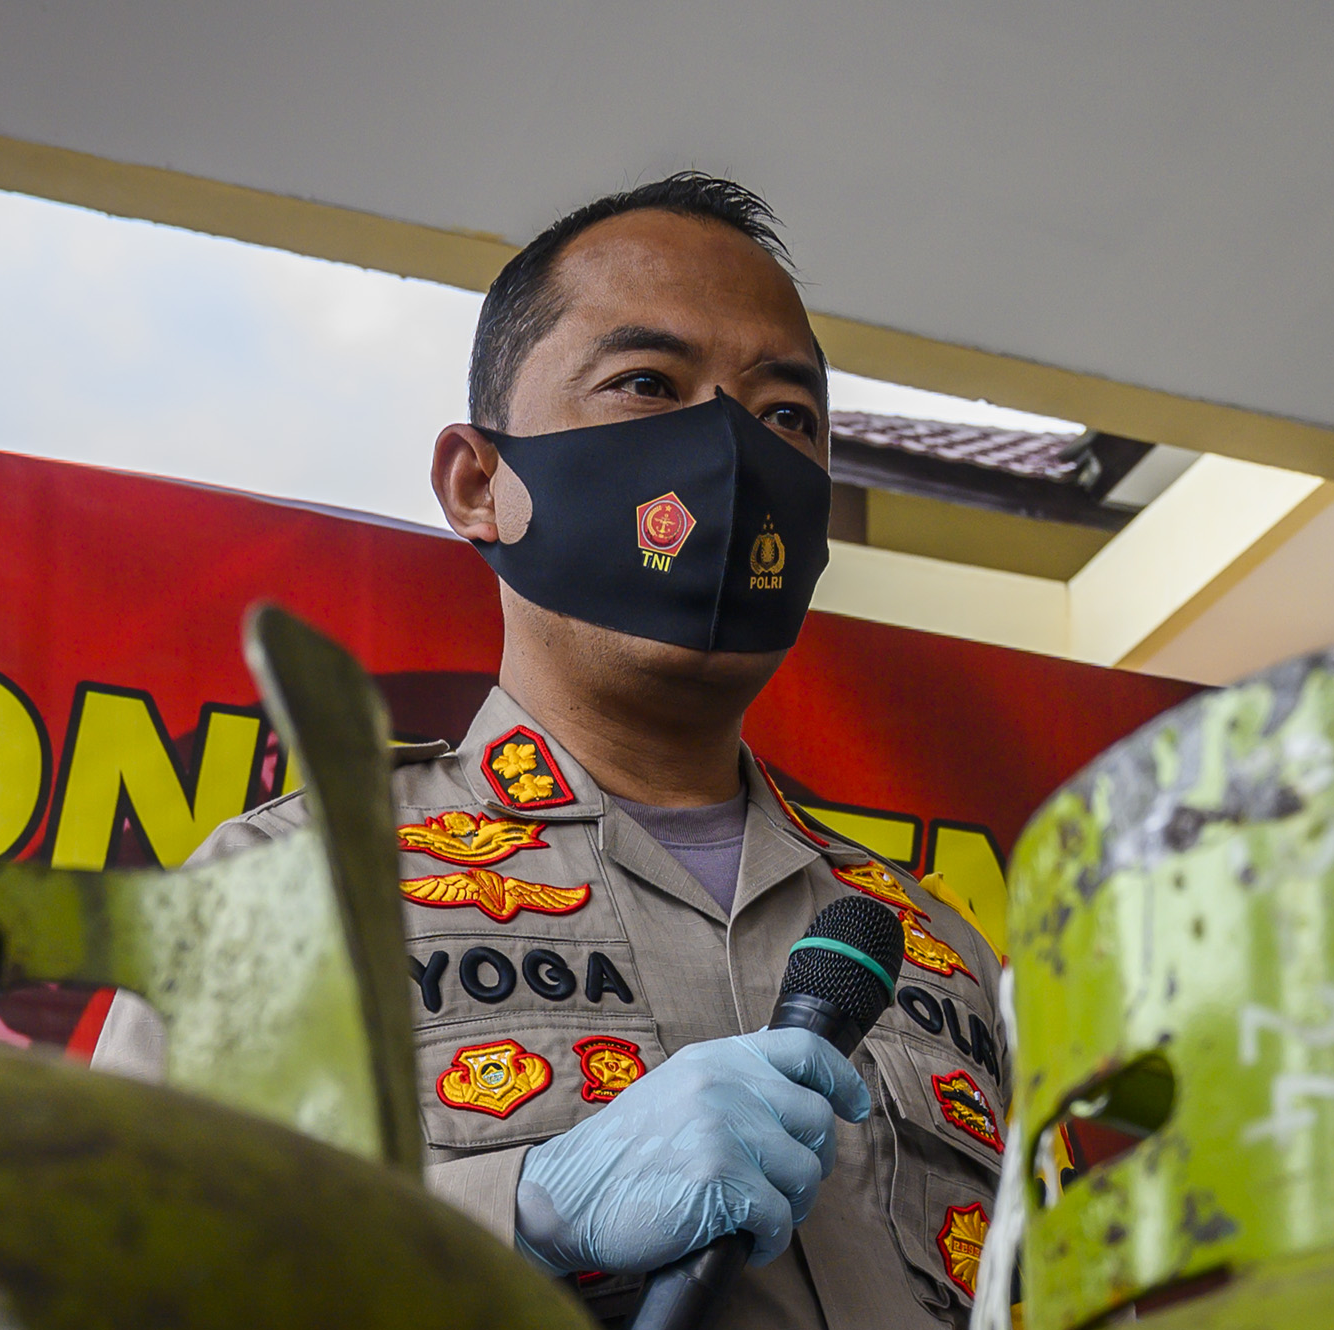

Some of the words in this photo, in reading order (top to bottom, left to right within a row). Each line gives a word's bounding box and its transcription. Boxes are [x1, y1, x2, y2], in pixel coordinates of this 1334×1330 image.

[641, 550, 672, 573] TNI
[749, 575, 783, 590] POLRI
[408, 946, 635, 1014] YOGA
[896, 985, 1002, 1087] OLRI
